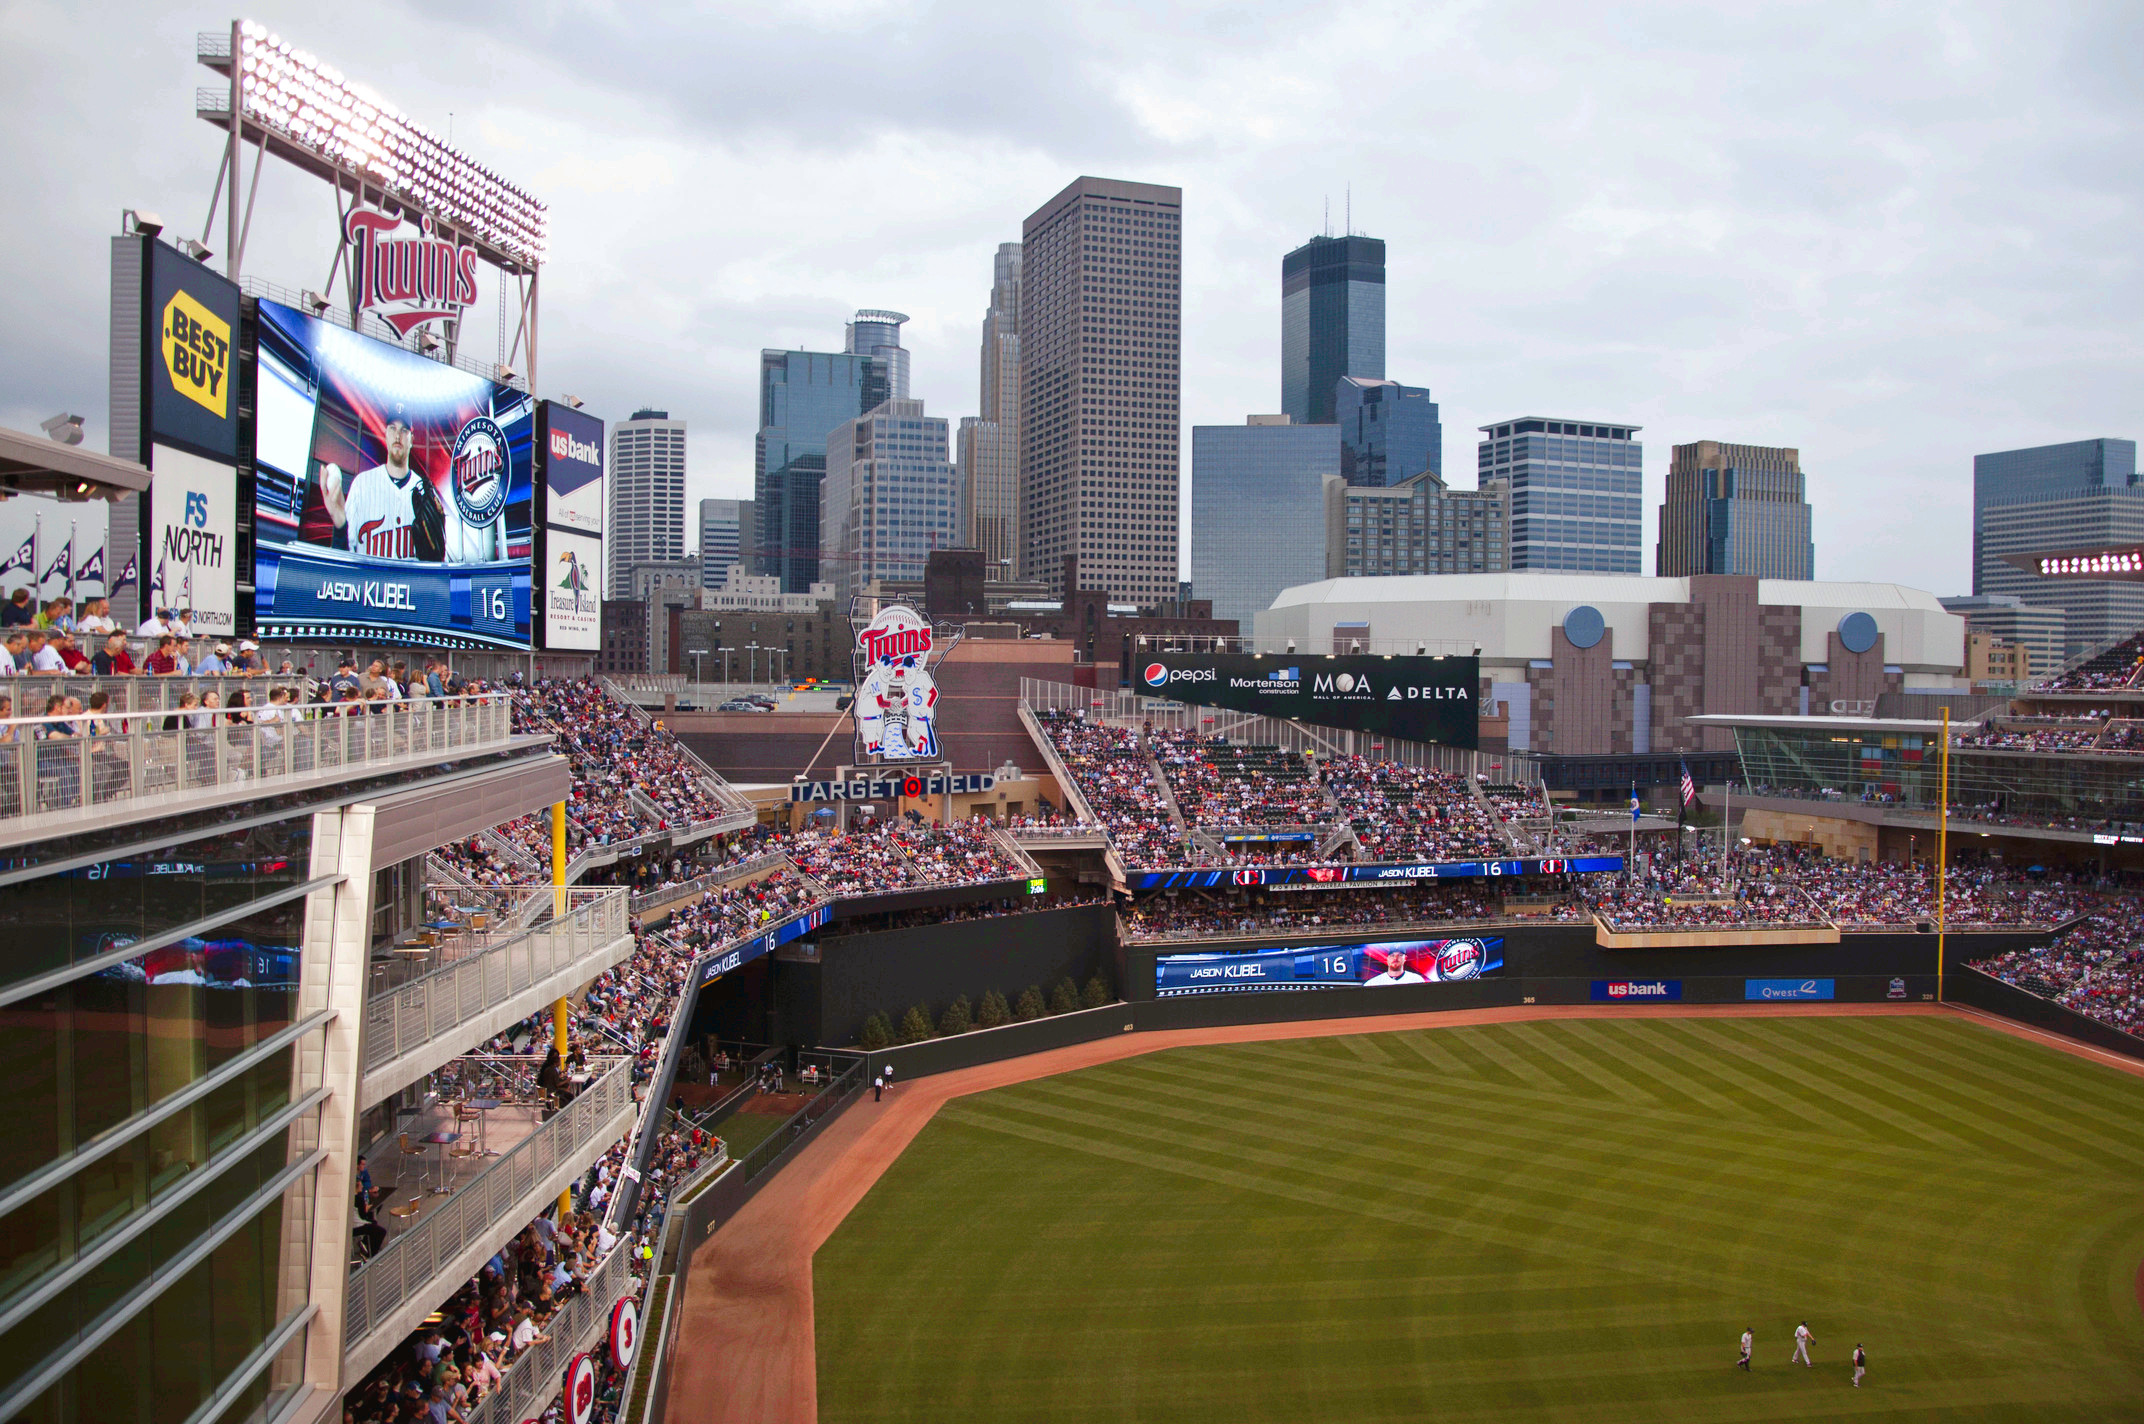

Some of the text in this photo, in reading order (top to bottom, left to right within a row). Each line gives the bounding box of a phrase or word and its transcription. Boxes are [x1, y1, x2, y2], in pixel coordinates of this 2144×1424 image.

[344, 207, 478, 314] Twins
[172, 305, 228, 370] BEST
[173, 341, 223, 398] BUY
[457, 421, 502, 451] MINNESOTA
[453, 444, 505, 495] Twins
[185, 490, 208, 528] FS
[456, 493, 503, 521] BASEBALL CLUB
[165, 524, 223, 568] NORTH
[317, 580, 506, 620] JASON KUBEL 16
[550, 591, 597, 613] Treasure Island
[550, 613, 570, 621] RESORT
[859, 623, 932, 668] Twins
[1170, 667, 1216, 683] pepsi
[1230, 678, 1299, 688] Mortenson
[912, 687, 923, 706] S
[1407, 686, 1468, 699] DELTA
[792, 774, 996, 801] TARGET FIELD
[1378, 869, 1404, 878] JASON
[1405, 866, 1438, 877] KUBEL
[1482, 861, 1501, 875] 16
[1031, 886, 1045, 894] 7:06
[764, 932, 776, 952] 16
[705, 951, 742, 979] JASON KUBEL
[1190, 956, 1347, 979] JASON KUBEL 16
[1438, 946, 1480, 973] Twins
[1762, 987, 1798, 998] Qwest
[624, 1317, 633, 1349] 3
